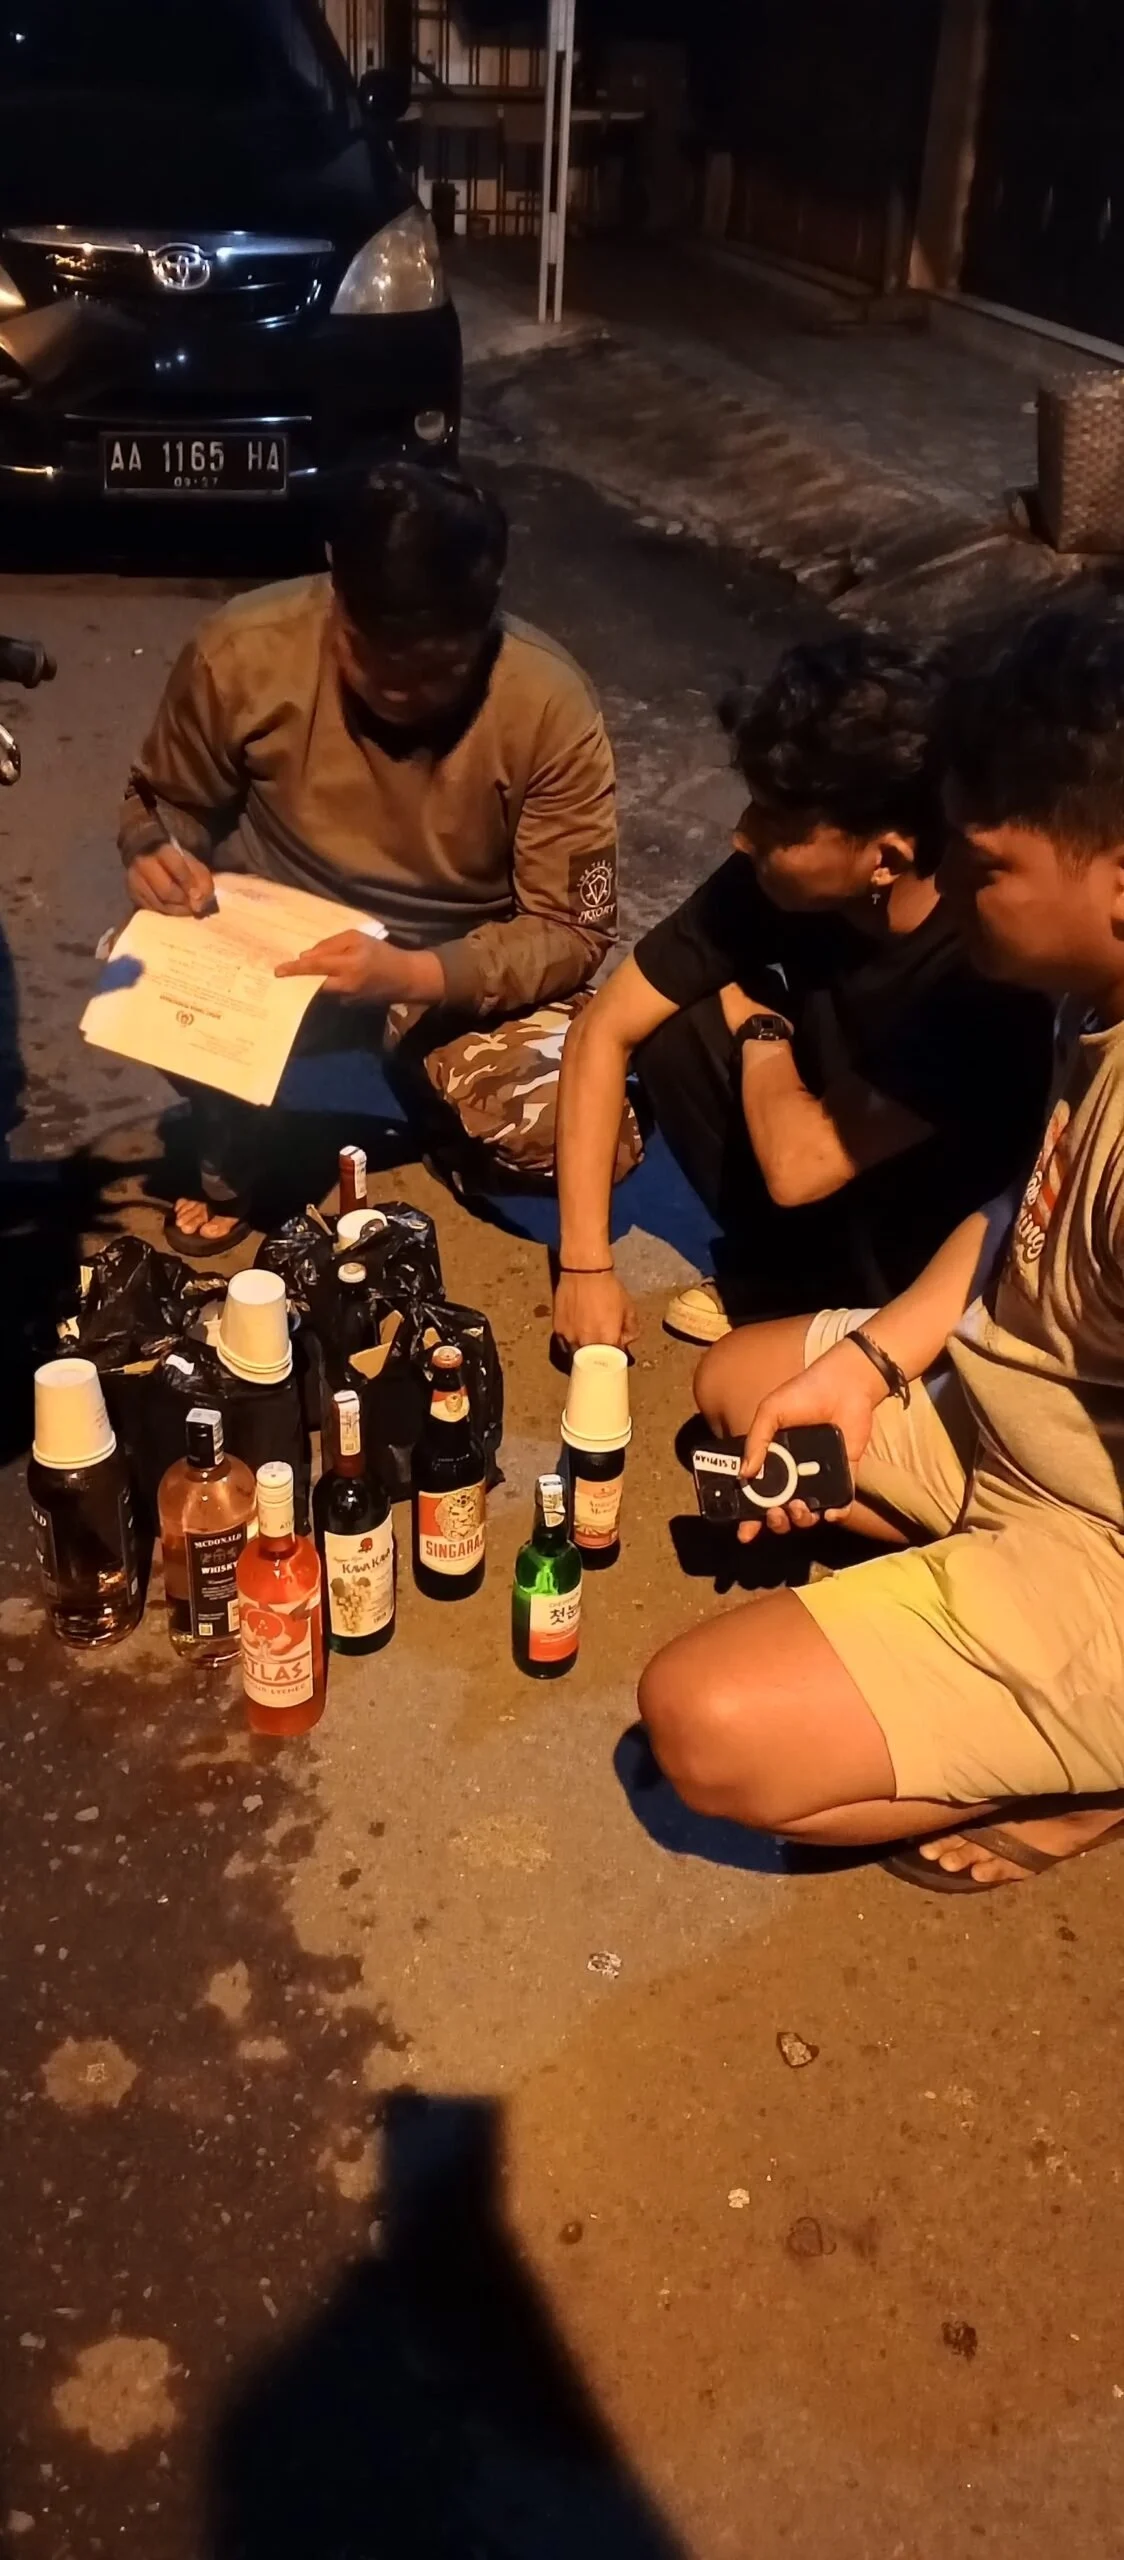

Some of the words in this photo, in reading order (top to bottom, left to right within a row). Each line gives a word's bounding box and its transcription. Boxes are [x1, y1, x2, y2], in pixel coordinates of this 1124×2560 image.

[110, 441, 142, 471] AA
[163, 441, 225, 472] 1165
[248, 441, 279, 472] HA
[201, 1560, 239, 1575] WHISKY
